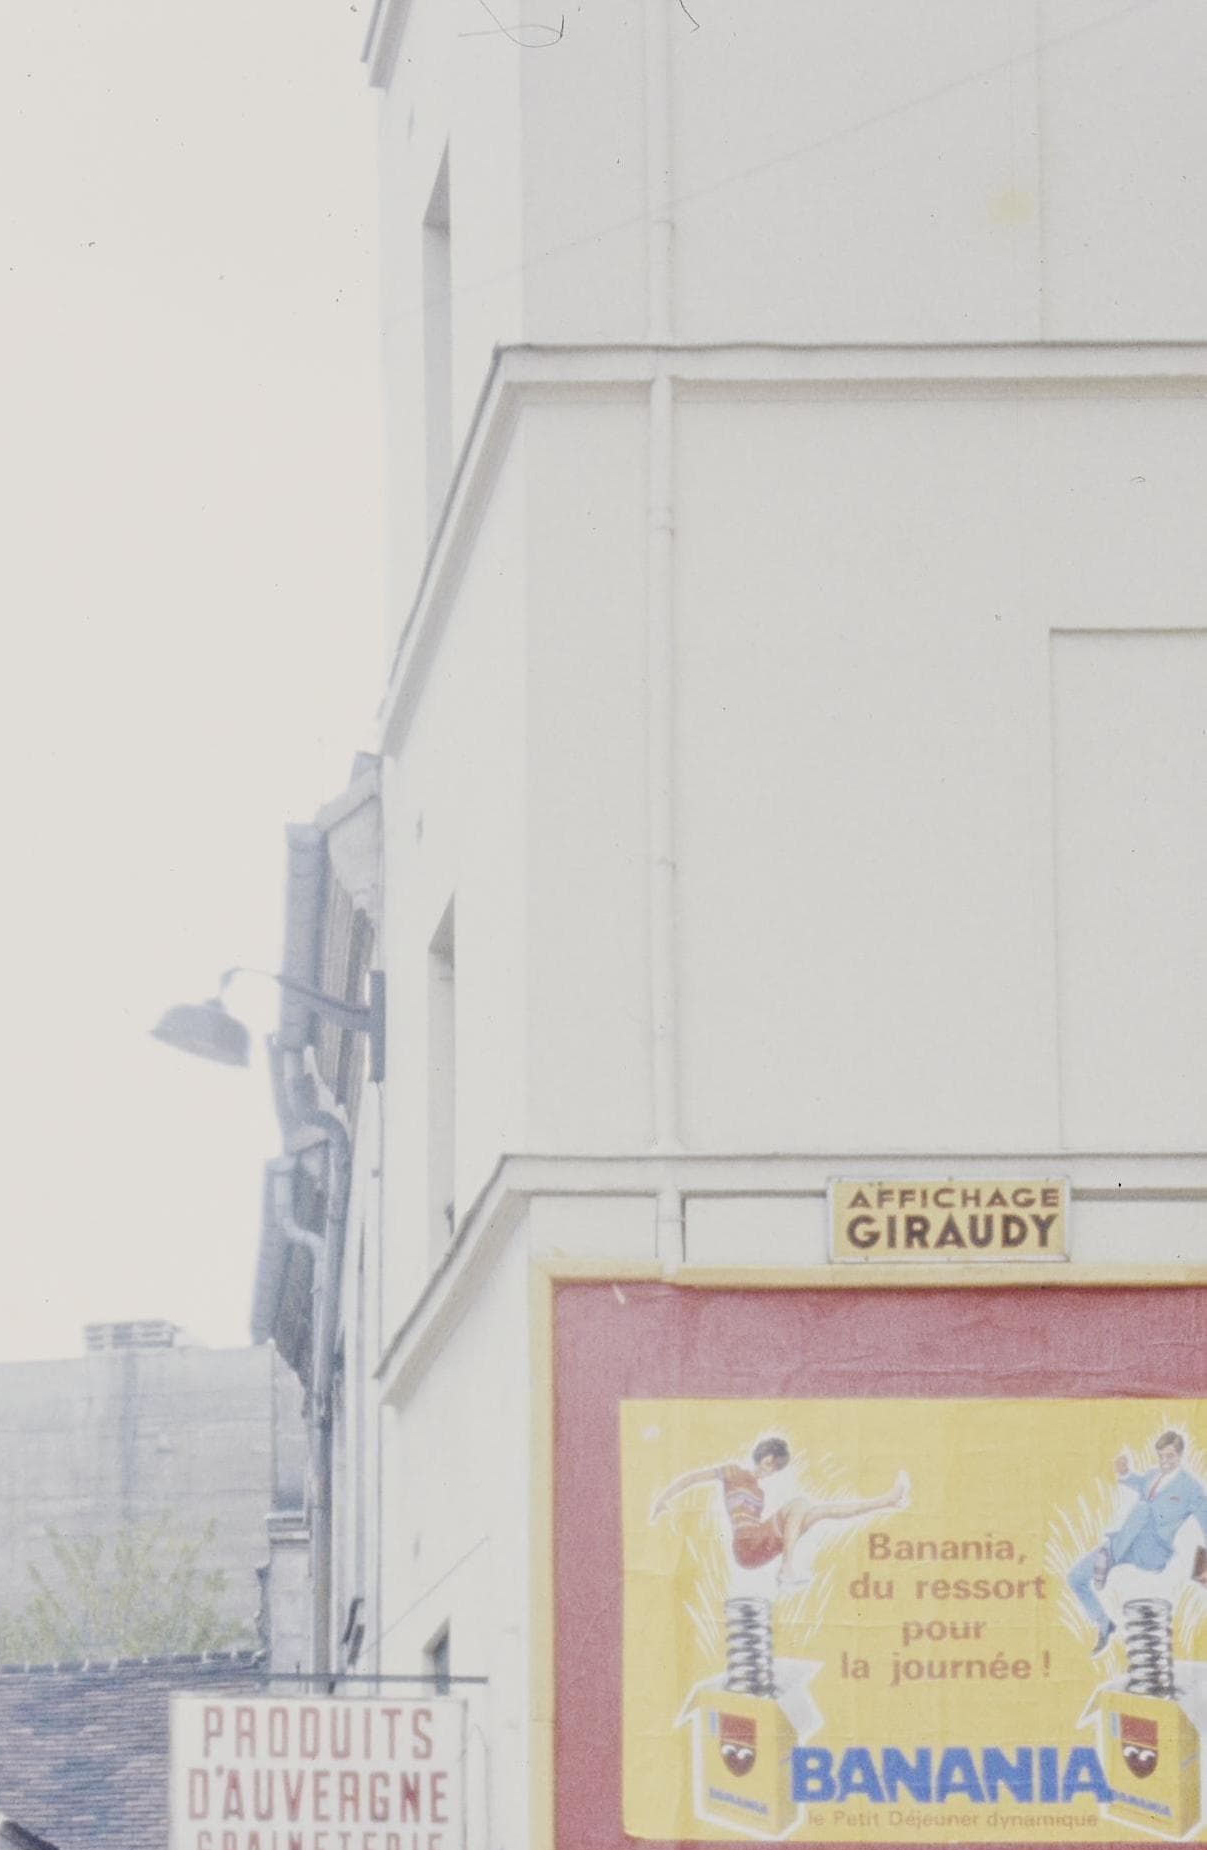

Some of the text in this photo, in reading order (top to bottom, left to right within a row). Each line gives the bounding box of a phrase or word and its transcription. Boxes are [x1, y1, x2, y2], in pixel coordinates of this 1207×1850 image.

[847, 1187, 1060, 1209] AFFICHAGE
[847, 1213, 1059, 1249] GIRAUDY
[868, 1533, 1028, 1565] Banania,
[849, 1571, 1047, 1600] du ressort
[902, 1620, 987, 1647] pour
[841, 1651, 870, 1680] la
[203, 1705, 434, 1760] PRODUITS
[791, 1746, 1112, 1803] BANANIA
[188, 1765, 449, 1823] D'AUVERGNE
[808, 1810, 1099, 1830] le Petit Déjeuner dynamique
